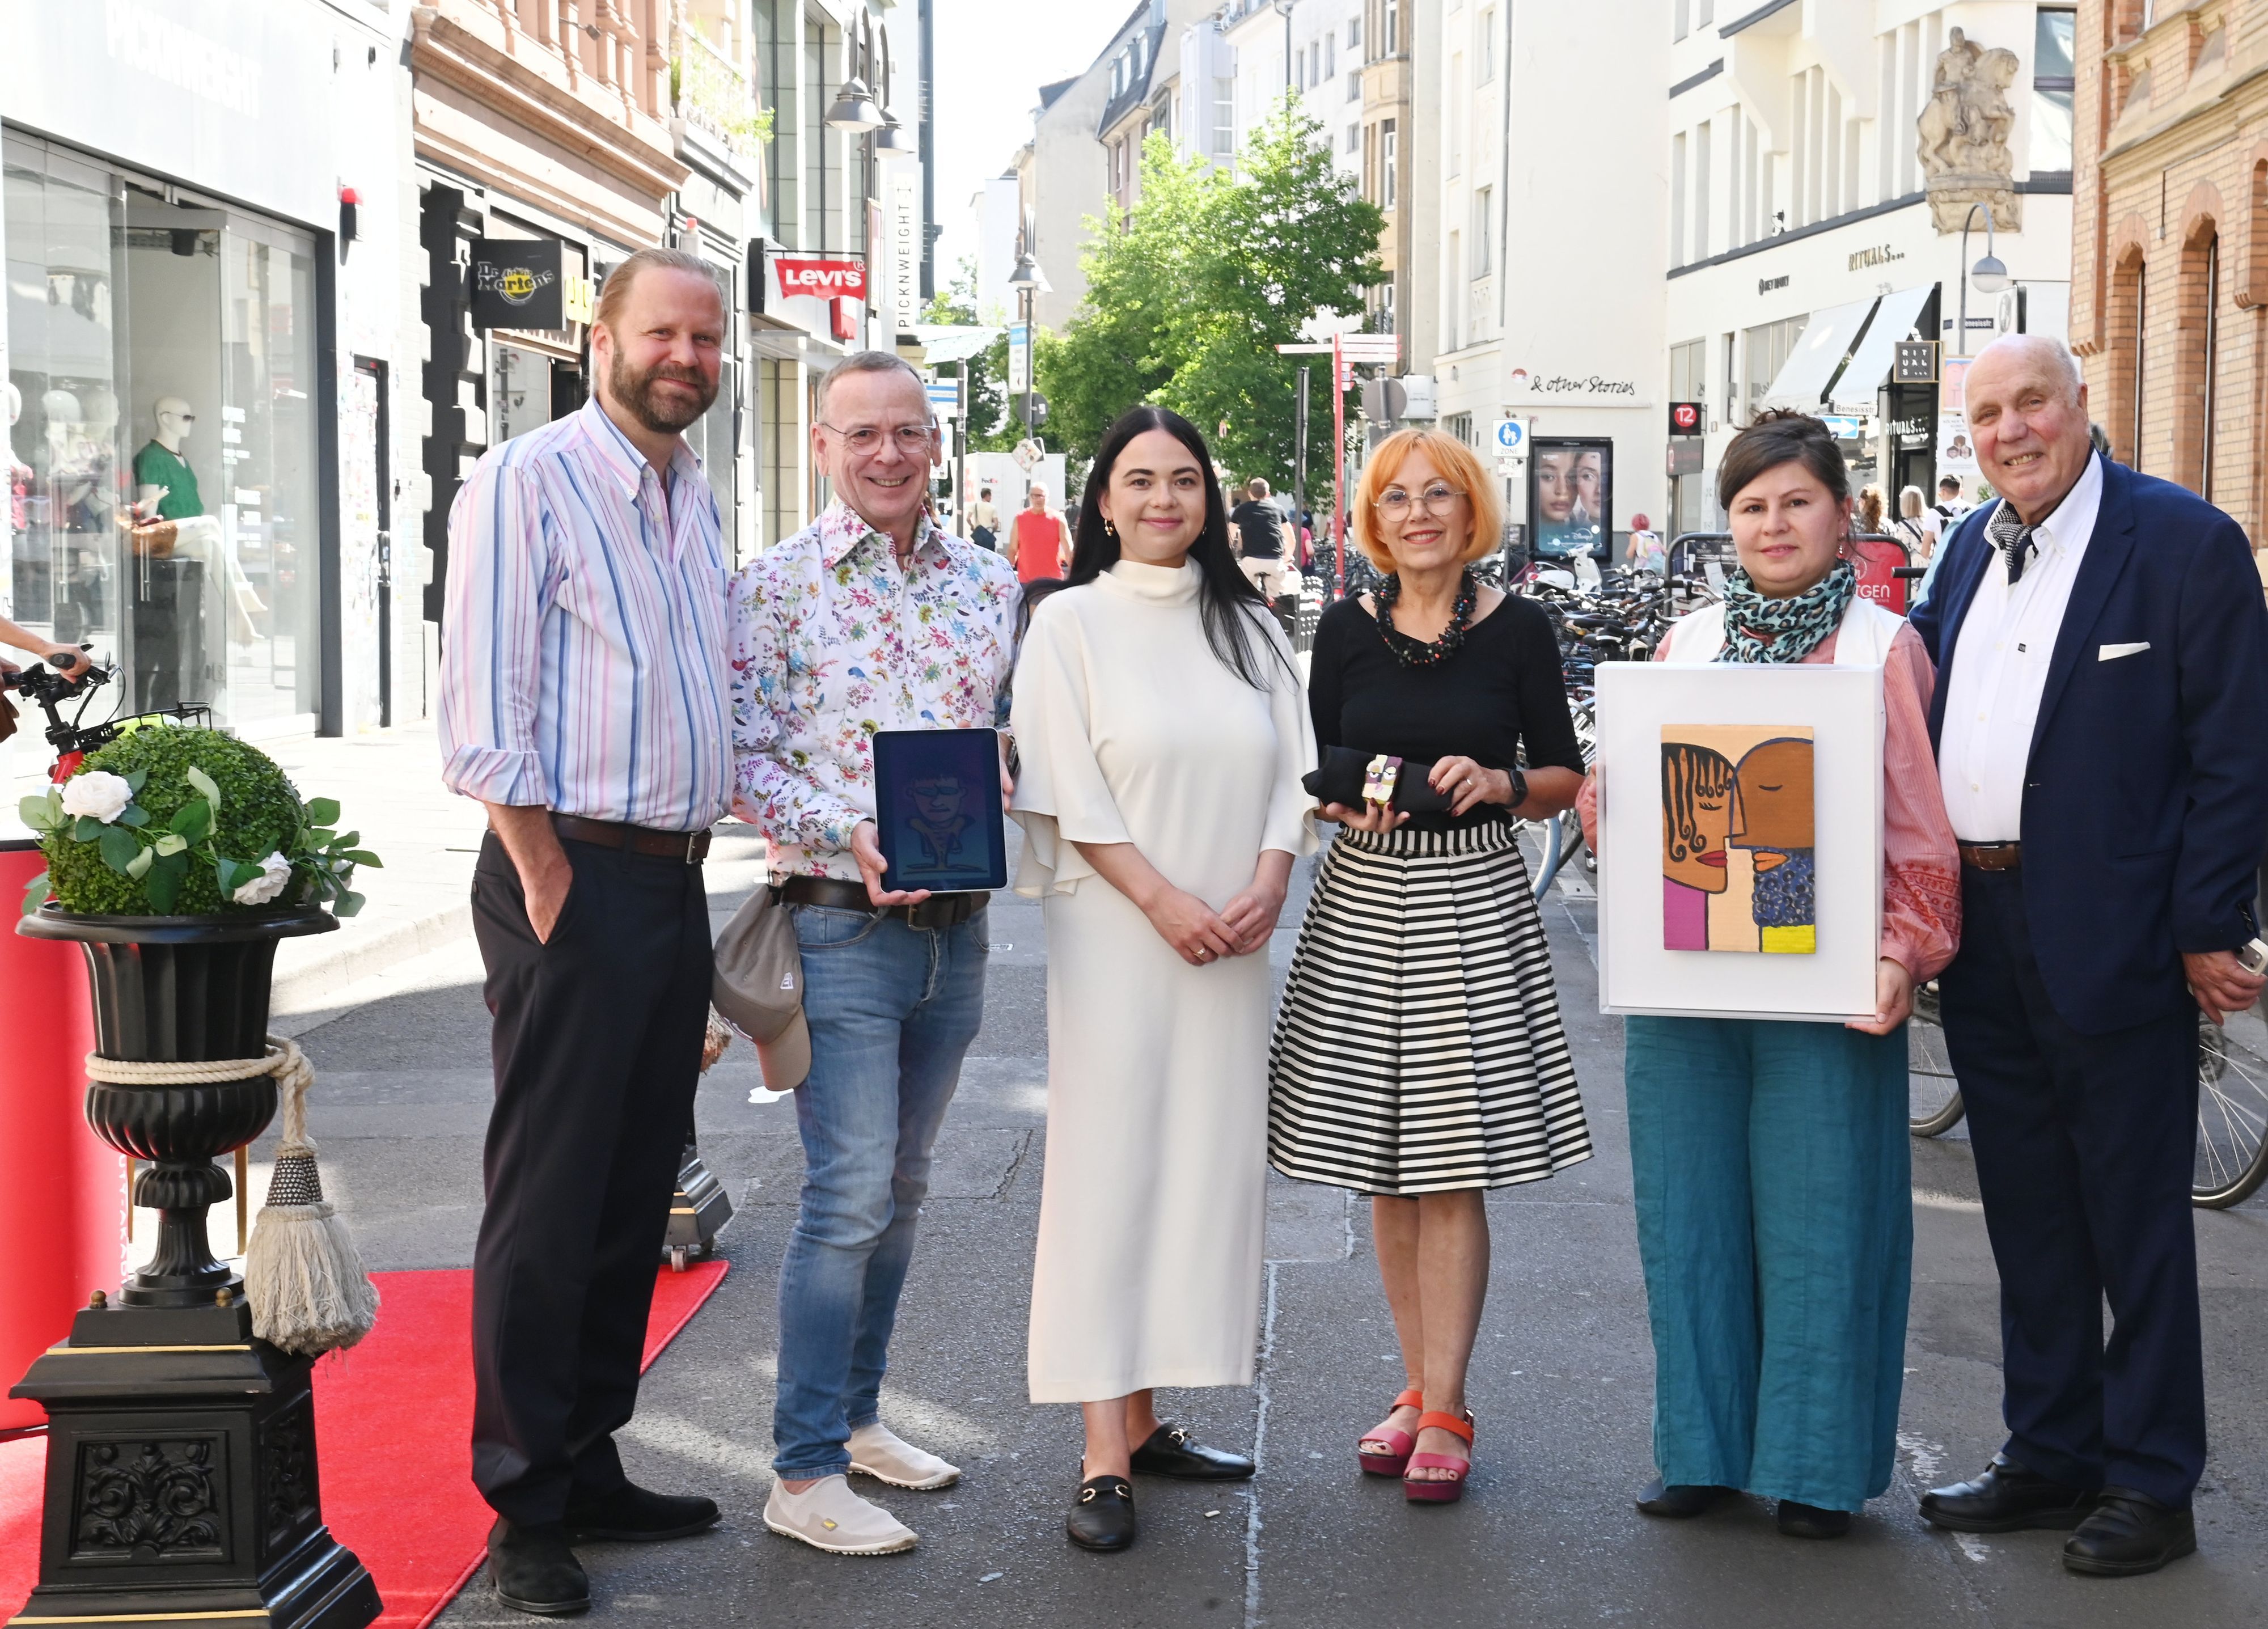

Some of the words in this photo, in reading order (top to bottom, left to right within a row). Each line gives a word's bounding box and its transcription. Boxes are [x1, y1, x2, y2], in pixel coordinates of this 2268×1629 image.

[898, 204, 909, 327] PICKNWEIGHT
[477, 269, 555, 290] Martens
[1965, 319, 1992, 328] enesisstr
[1530, 375, 1543, 393] &
[1855, 584, 1890, 598] TGEN
[119, 1153, 128, 1284] UTY-AKAD
